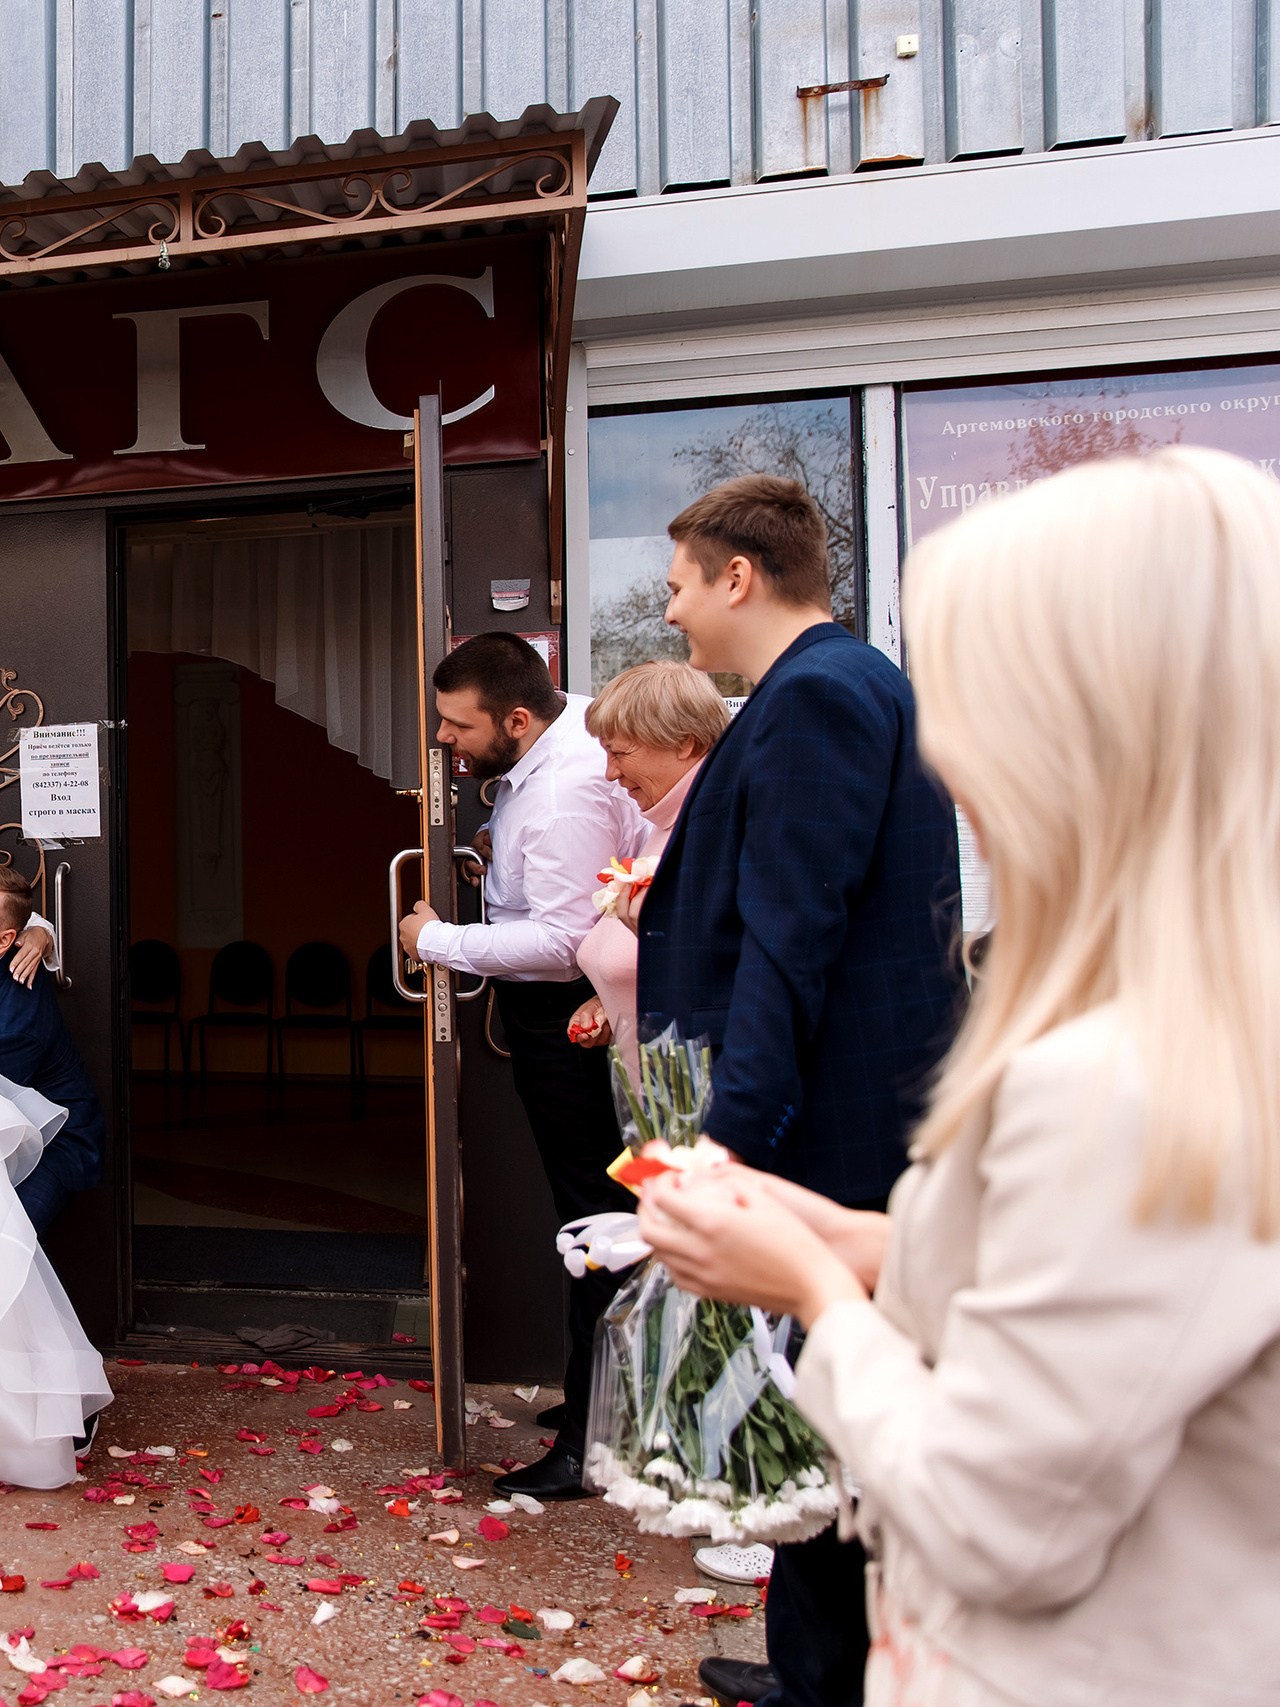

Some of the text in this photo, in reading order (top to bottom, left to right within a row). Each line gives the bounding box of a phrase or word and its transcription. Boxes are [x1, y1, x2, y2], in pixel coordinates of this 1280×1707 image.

[941, 413, 1084, 438] Артемовского
[1093, 401, 1211, 425] городского
[916, 474, 1042, 516] Управл
[33, 729, 86, 739] Внимание!!!
[28, 809, 57, 818] строго
